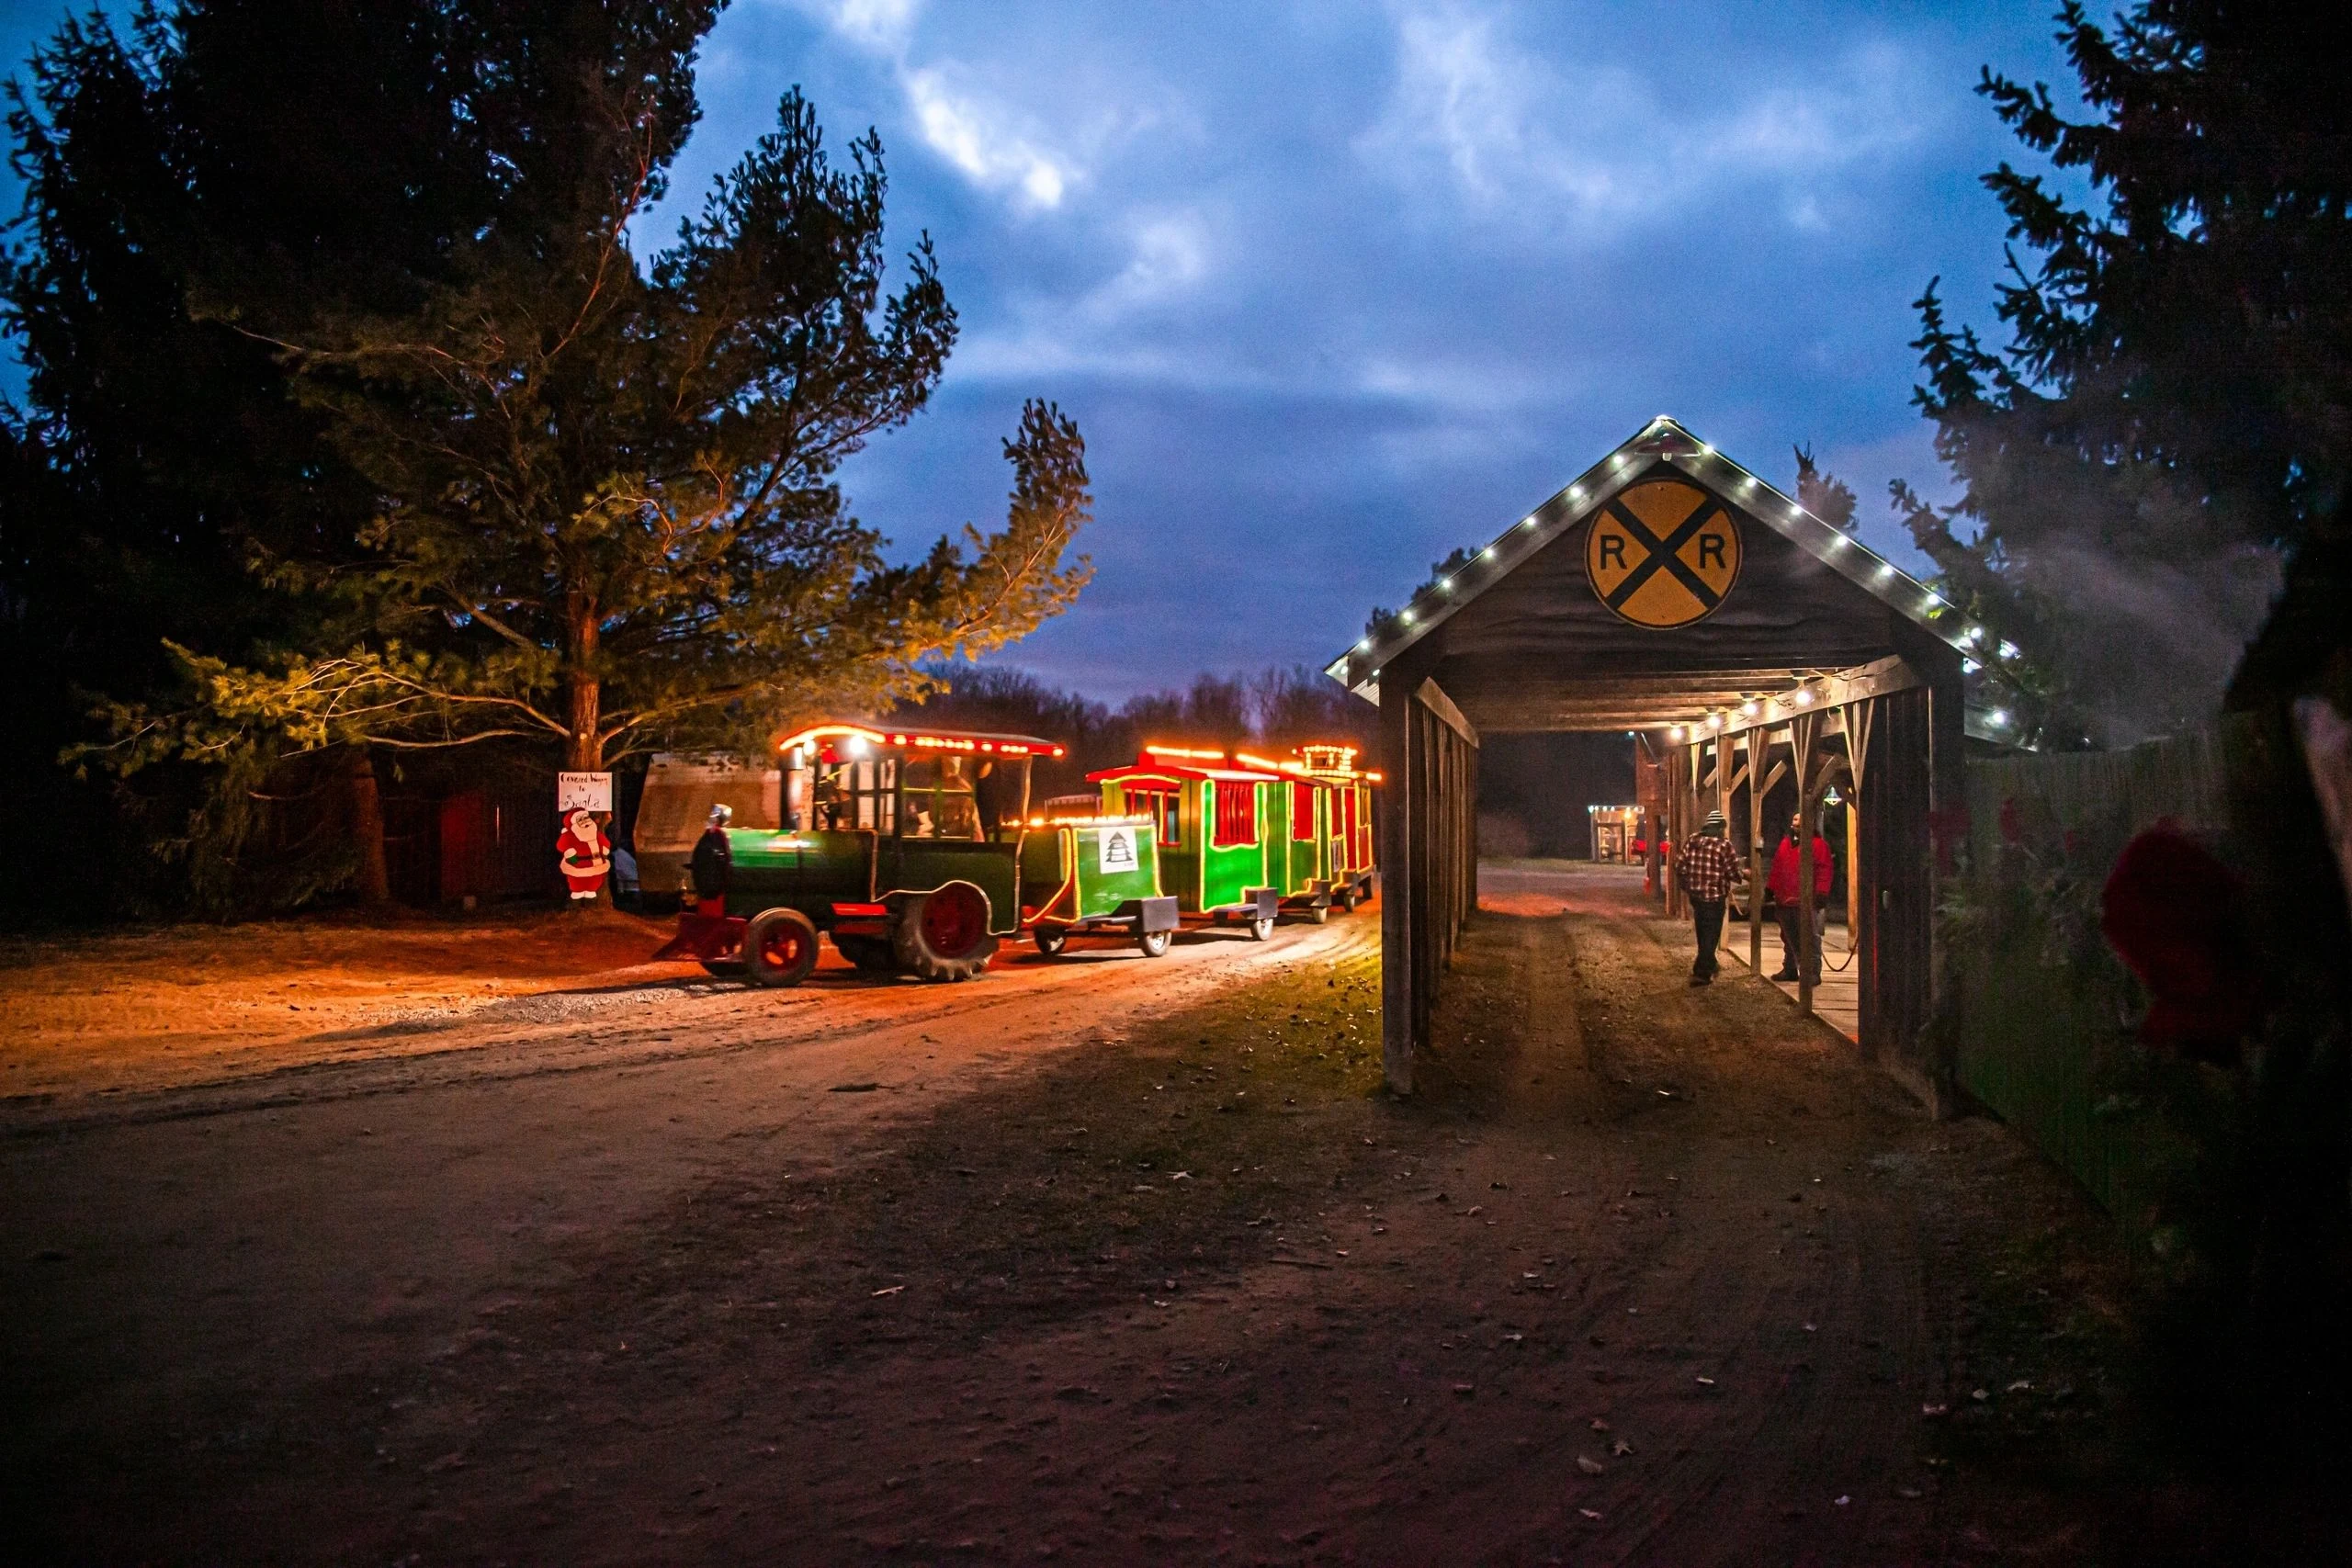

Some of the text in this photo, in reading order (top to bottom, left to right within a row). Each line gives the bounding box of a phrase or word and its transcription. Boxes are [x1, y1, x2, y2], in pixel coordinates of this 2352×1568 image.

[1600, 534, 1726, 570] R R
[564, 794, 600, 808] Santa
